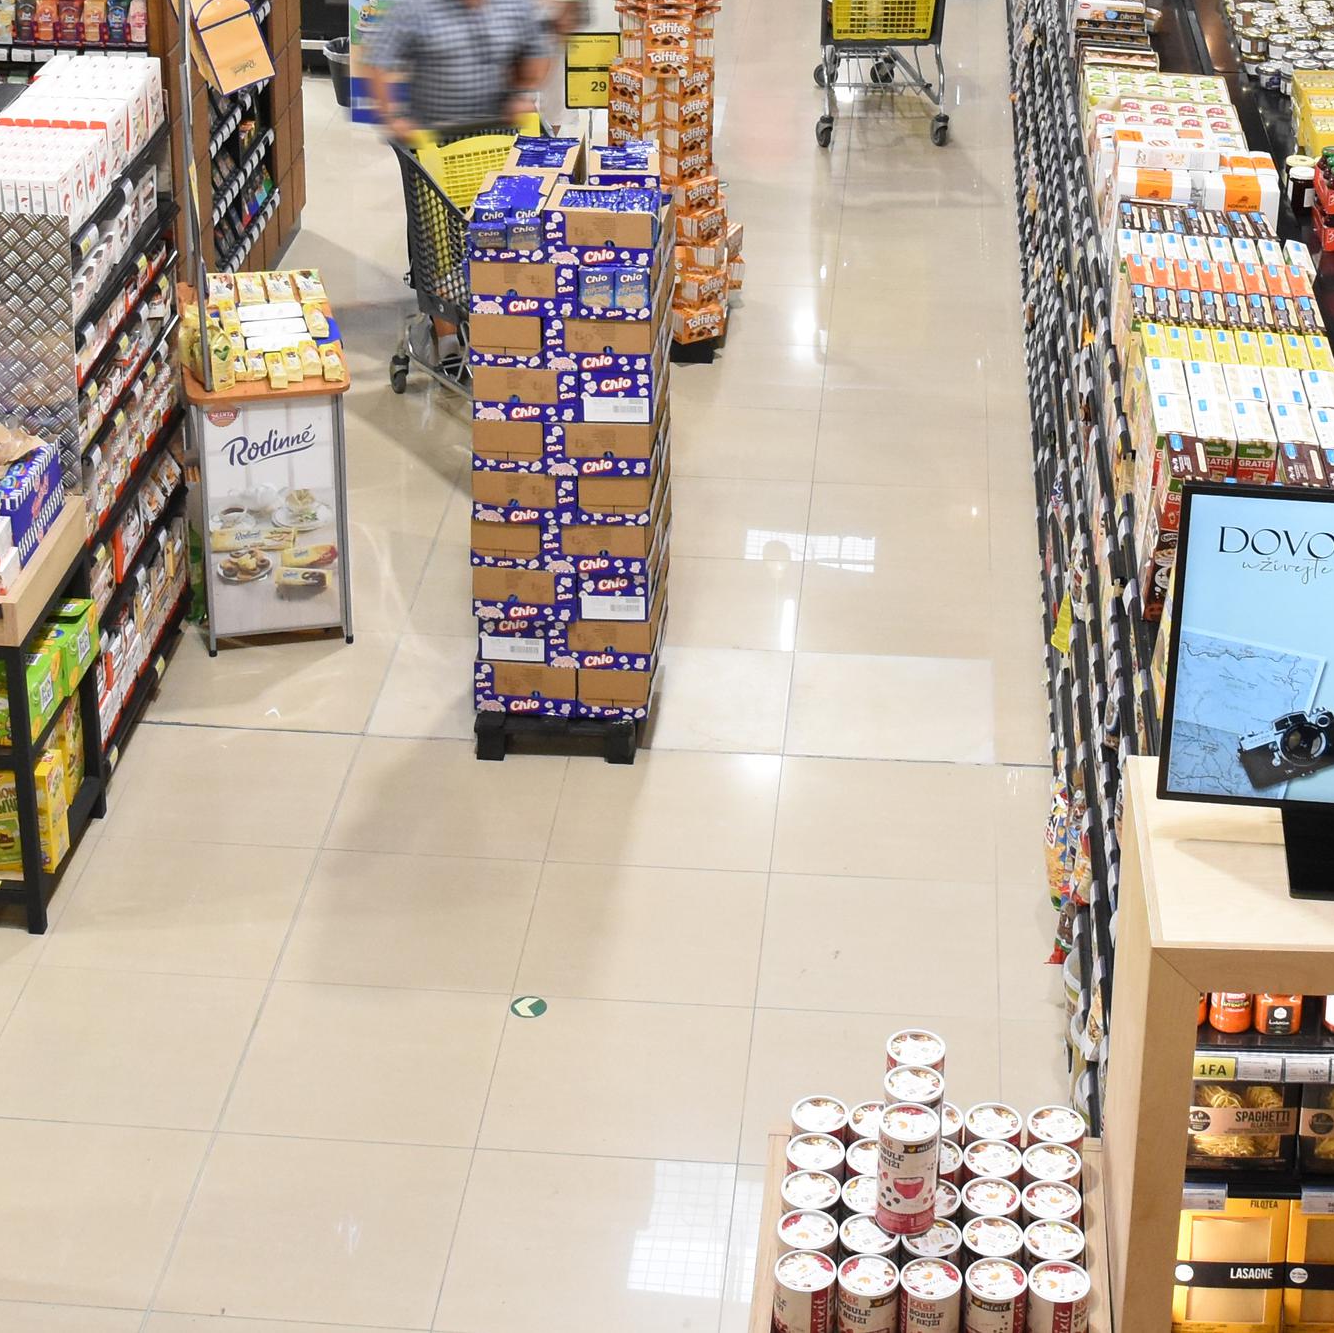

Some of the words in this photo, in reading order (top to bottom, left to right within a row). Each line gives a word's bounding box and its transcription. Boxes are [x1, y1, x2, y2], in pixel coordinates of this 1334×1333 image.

[649, 22, 691, 35] Toffifee
[648, 51, 689, 64] Toffifee
[591, 80, 607, 92] 29
[482, 210, 504, 221] Chio
[547, 230, 563, 239] Chio
[583, 249, 615, 263] Chio
[585, 274, 607, 283] Chio
[621, 272, 643, 283] Chio
[509, 299, 539, 313] Chio
[686, 314, 721, 330] Toffifee
[582, 354, 613, 368] Chio
[601, 378, 632, 392] Chio
[511, 406, 541, 418] Chio
[221, 424, 316, 467] Rodinné
[583, 459, 613, 474] Chio
[1207, 458, 1233, 466] RATIS!
[1238, 459, 1274, 468] GRATIS!
[511, 510, 539, 522] Chio
[579, 558, 609, 571] Chio
[599, 577, 628, 591] Chio
[509, 606, 538, 618] Chio
[499, 618, 529, 632] Chio
[584, 654, 615, 666] Chio
[509, 699, 540, 712] Chio
[1199, 1064, 1227, 1076] 1FA
[1235, 1110, 1291, 1124] SPAGHETTI
[1229, 1268, 1273, 1280] LASAGNE
[909, 1310, 945, 1319] BOBULE
[918, 1316, 941, 1328] REJŽI
[1058, 1309, 1071, 1333] ixit
